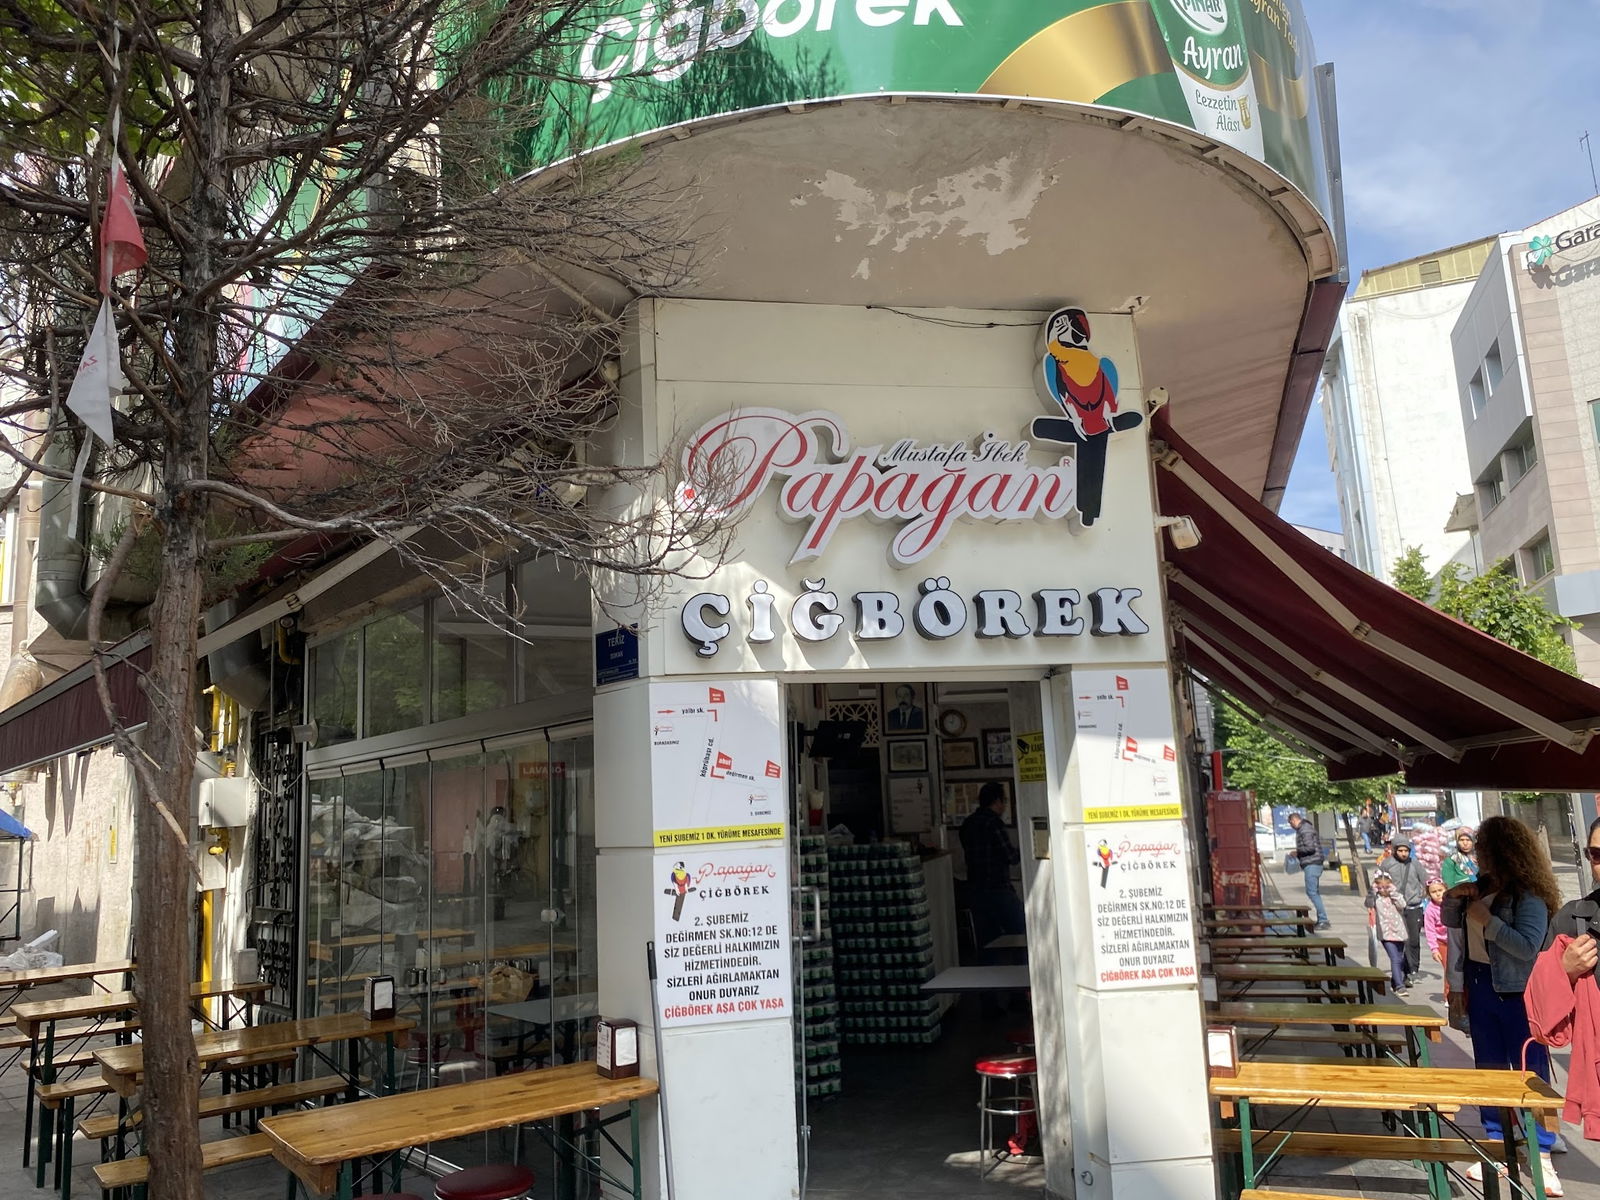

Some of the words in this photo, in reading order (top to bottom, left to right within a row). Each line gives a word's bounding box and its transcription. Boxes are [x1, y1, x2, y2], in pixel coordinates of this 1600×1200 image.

[1250, 0, 1280, 30] yran
[1183, 36, 1243, 79] Ayran
[1195, 89, 1237, 111] Lezzetin
[883, 440, 968, 467] Mustafa
[972, 432, 1029, 463] İbek
[678, 414, 1073, 558] Papağan
[681, 576, 1149, 657] ÇİĞBÖREK
[523, 766, 562, 775] LAVAO
[660, 833, 672, 843] YENİ
[742, 827, 781, 837] MESAFESİNDE
[699, 885, 769, 900] ÇİĞBÖREK
[1120, 890, 1127, 898] 2.
[1129, 886, 1163, 899] ŞUBEMİZ
[1098, 901, 1138, 914] DEĞİRMEN
[1140, 901, 1174, 911] SK.NO:12
[1176, 900, 1186, 909] DE
[694, 916, 703, 926] 2.
[706, 912, 749, 927] ŞUBEMİZ
[1098, 916, 1110, 927] SİZ
[1112, 914, 1143, 926] DEĞERLİ
[1145, 913, 1188, 926] HALKIMIZIN
[666, 929, 716, 944] DEĞİRMEN
[720, 926, 762, 939] SK.NO:12
[766, 925, 778, 935] DE
[1114, 926, 1175, 940] HİZMETİNDEDİR.
[664, 946, 680, 958] SİZ
[682, 942, 722, 957] DEĞERLİ
[725, 940, 780, 953] HALKIMIZIN
[1101, 942, 1130, 954] SİZLERİ
[1132, 940, 1190, 953] AĞIRLAMAKTAN
[684, 956, 762, 972] HİZMETİNDEDİR.
[1120, 956, 1140, 966] ONUR
[1143, 954, 1174, 966] DUYARIZ
[666, 974, 702, 988] SİZLERİ
[706, 968, 780, 982] AĞIRLAMAKTAN
[1101, 970, 1139, 982] ÇİĞBÖREK
[1142, 968, 1156, 980] AŞA
[1158, 968, 1173, 979] ÇOK
[1175, 966, 1194, 978] YAŞA
[689, 989, 716, 1001] ONUR
[720, 986, 760, 998] DUYARIZ
[664, 1004, 713, 1019] ÇİĞBÖREK
[716, 1002, 735, 1014] AŞA
[738, 1000, 758, 1012] ÇOK
[760, 998, 784, 1010] YAŞA
